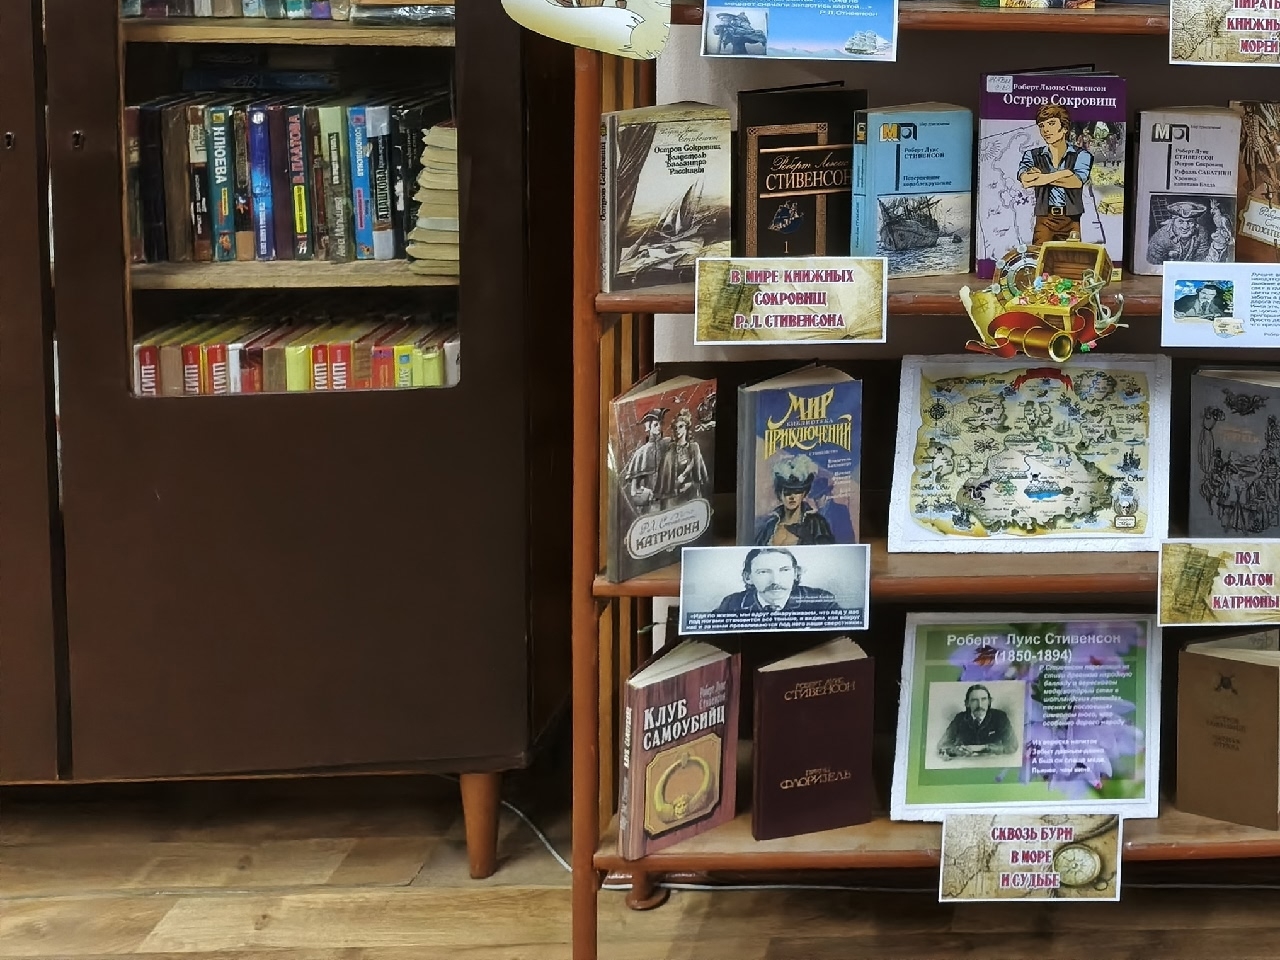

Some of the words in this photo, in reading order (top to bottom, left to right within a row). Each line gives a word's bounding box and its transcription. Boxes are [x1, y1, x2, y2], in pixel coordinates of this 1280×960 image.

[1240, 38, 1279, 53] МОРЕЙ
[1003, 93, 1048, 108] Остров
[1050, 94, 1117, 108] Сокровищ
[765, 170, 853, 190] СТИВЕНСОН
[731, 270, 741, 283] В
[746, 270, 779, 283] МИРЕ
[784, 269, 854, 282] КНИЖНЫХ
[754, 292, 827, 306] СОКРОВИЩ
[765, 314, 845, 329] СТИВЕНСОНА
[636, 519, 700, 551] КАТРИОНА
[1235, 551, 1261, 565] ПОД
[1223, 573, 1274, 587] ФЛАГОМ
[1212, 595, 1280, 610] КАТРИОНЫ
[947, 635, 998, 647] Роберт
[1005, 633, 1041, 646] Луис
[1044, 632, 1121, 645] Стивенсон
[994, 649, 1072, 663] (1850-1894)
[643, 698, 687, 731] КЛУБ
[643, 705, 725, 752] САМОУБИЙЦ
[991, 827, 1037, 841] СКВОЗЬ
[1040, 827, 1073, 840] БУРИ
[1021, 850, 1052, 864] МОРЕ
[1012, 873, 1060, 889] СУДЬБЕ
